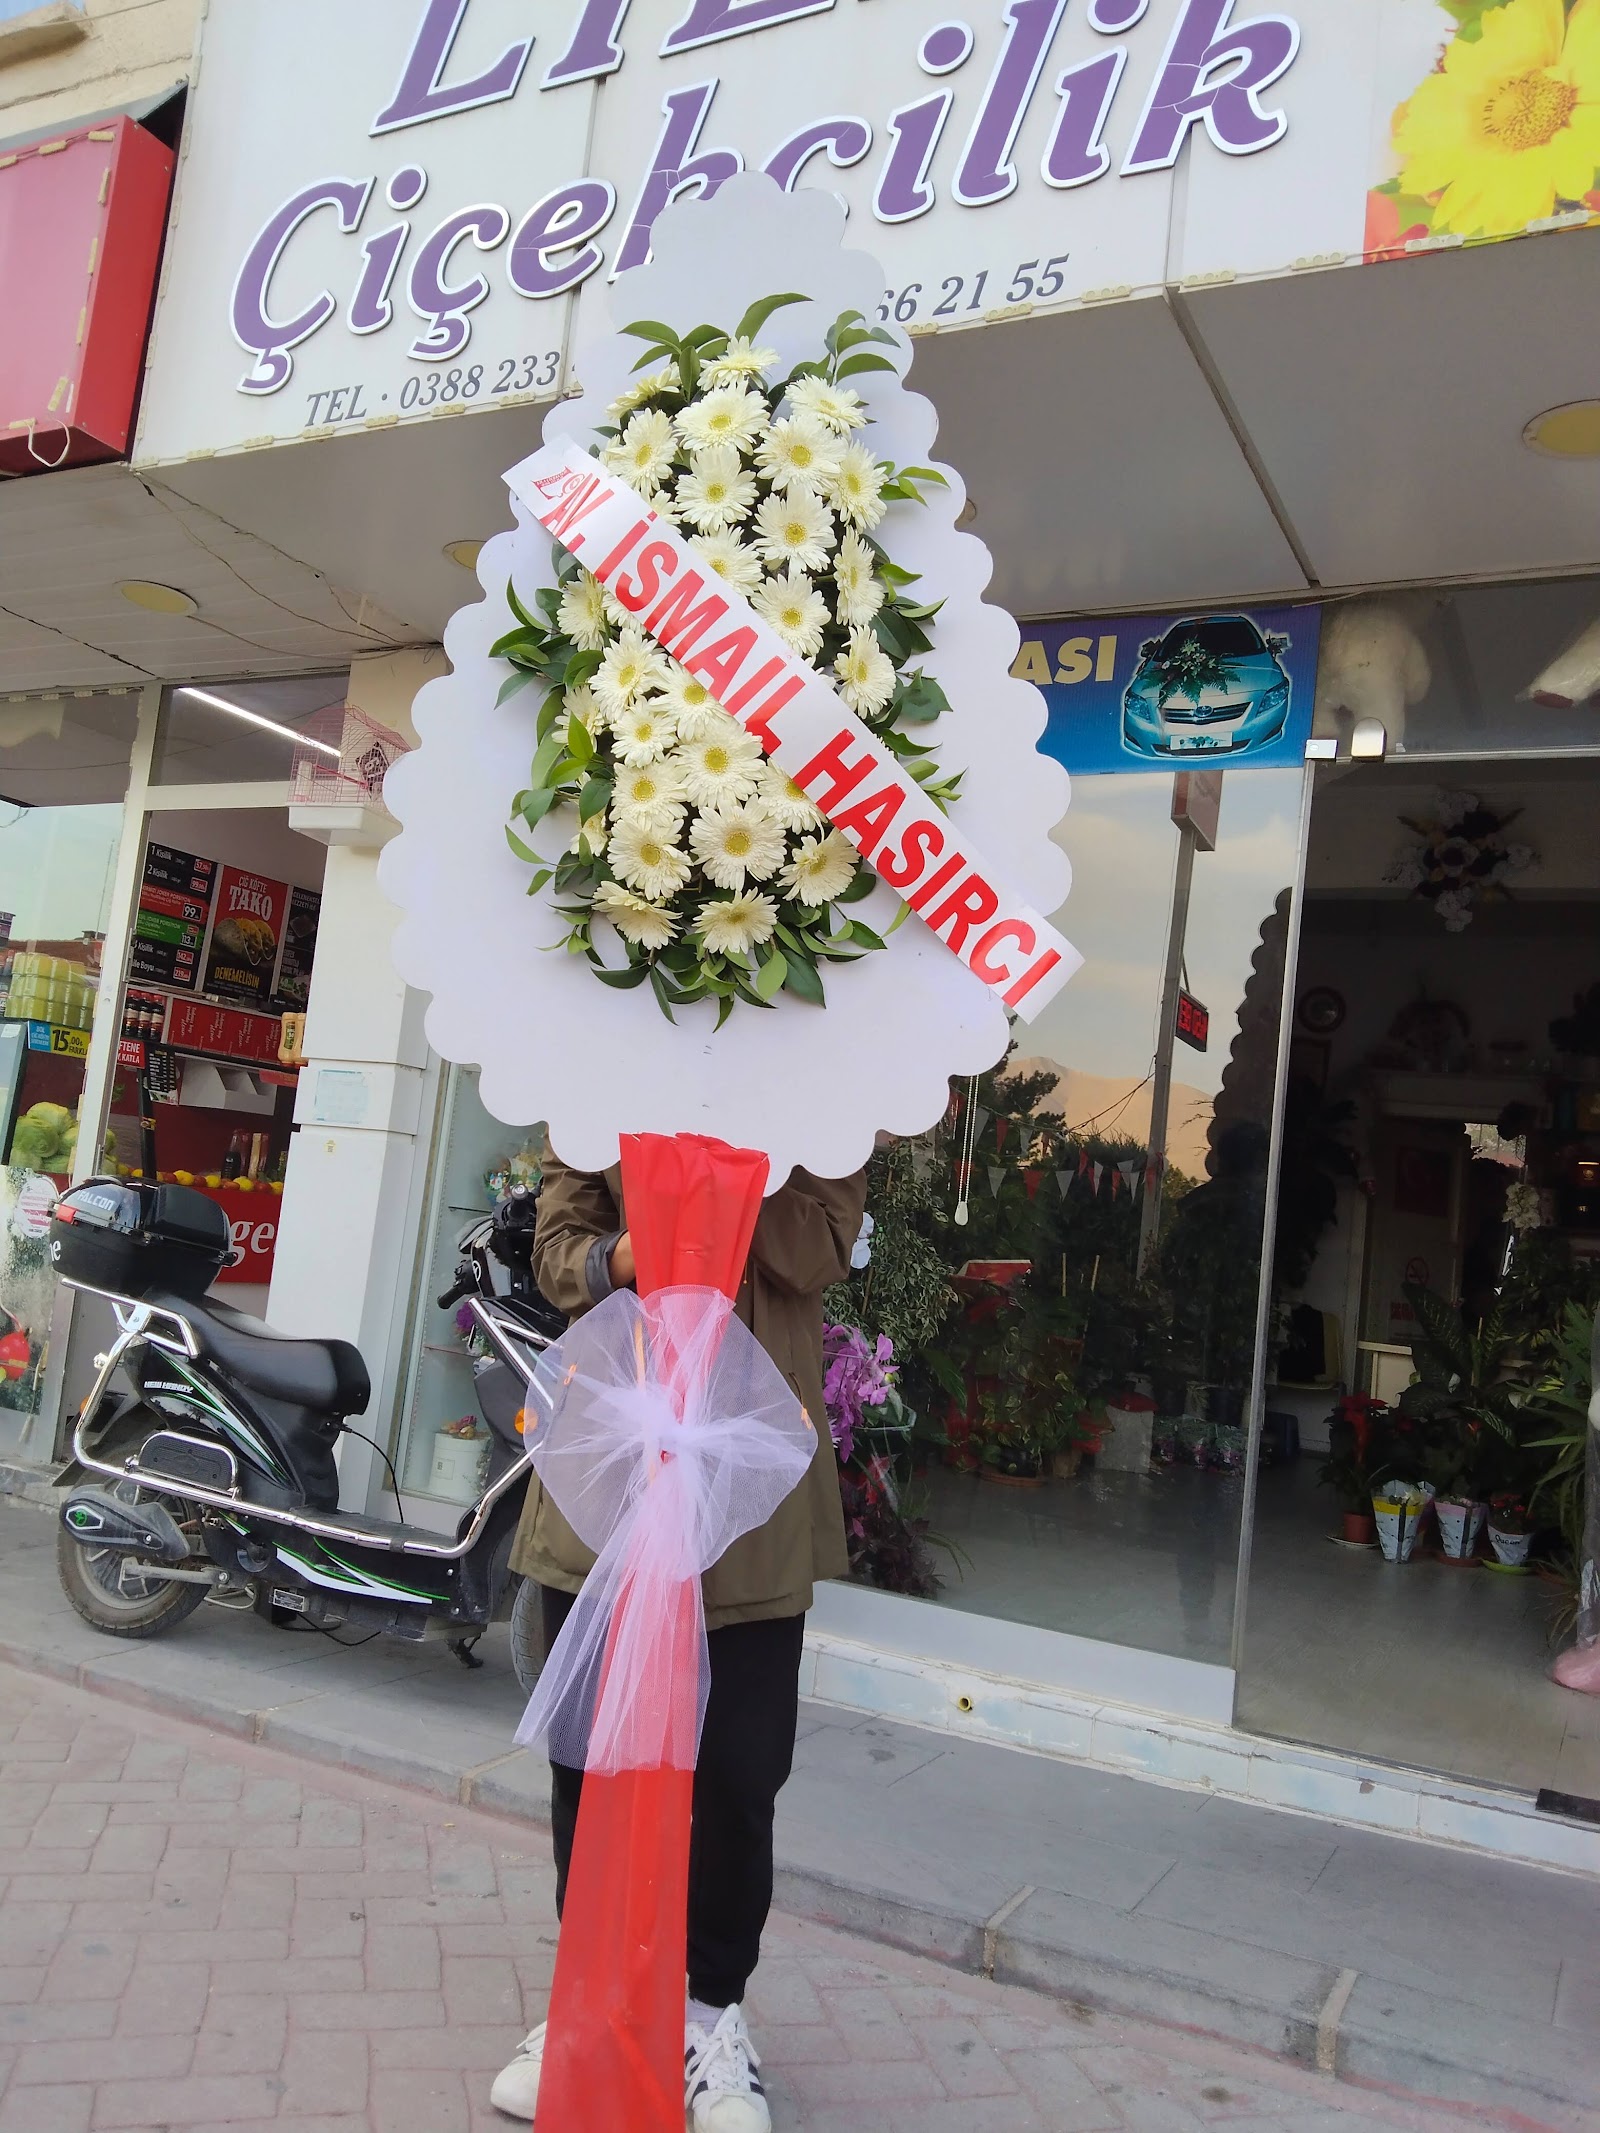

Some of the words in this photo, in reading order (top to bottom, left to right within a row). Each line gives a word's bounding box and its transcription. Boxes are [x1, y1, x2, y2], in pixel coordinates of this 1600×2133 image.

[305, 385, 367, 427] TEL
[400, 364, 484, 410] 0388
[491, 351, 561, 394] 233
[932, 270, 989, 316] 21
[1006, 253, 1070, 302] 55
[147, 865, 153, 875] 2
[792, 728, 1062, 1008] HASIRCI
[249, 878, 268, 894] KÖFTE
[228, 885, 273, 921] TAKO
[122, 1053, 140, 1063] KATLA
[78, 1190, 115, 1211] FALCON
